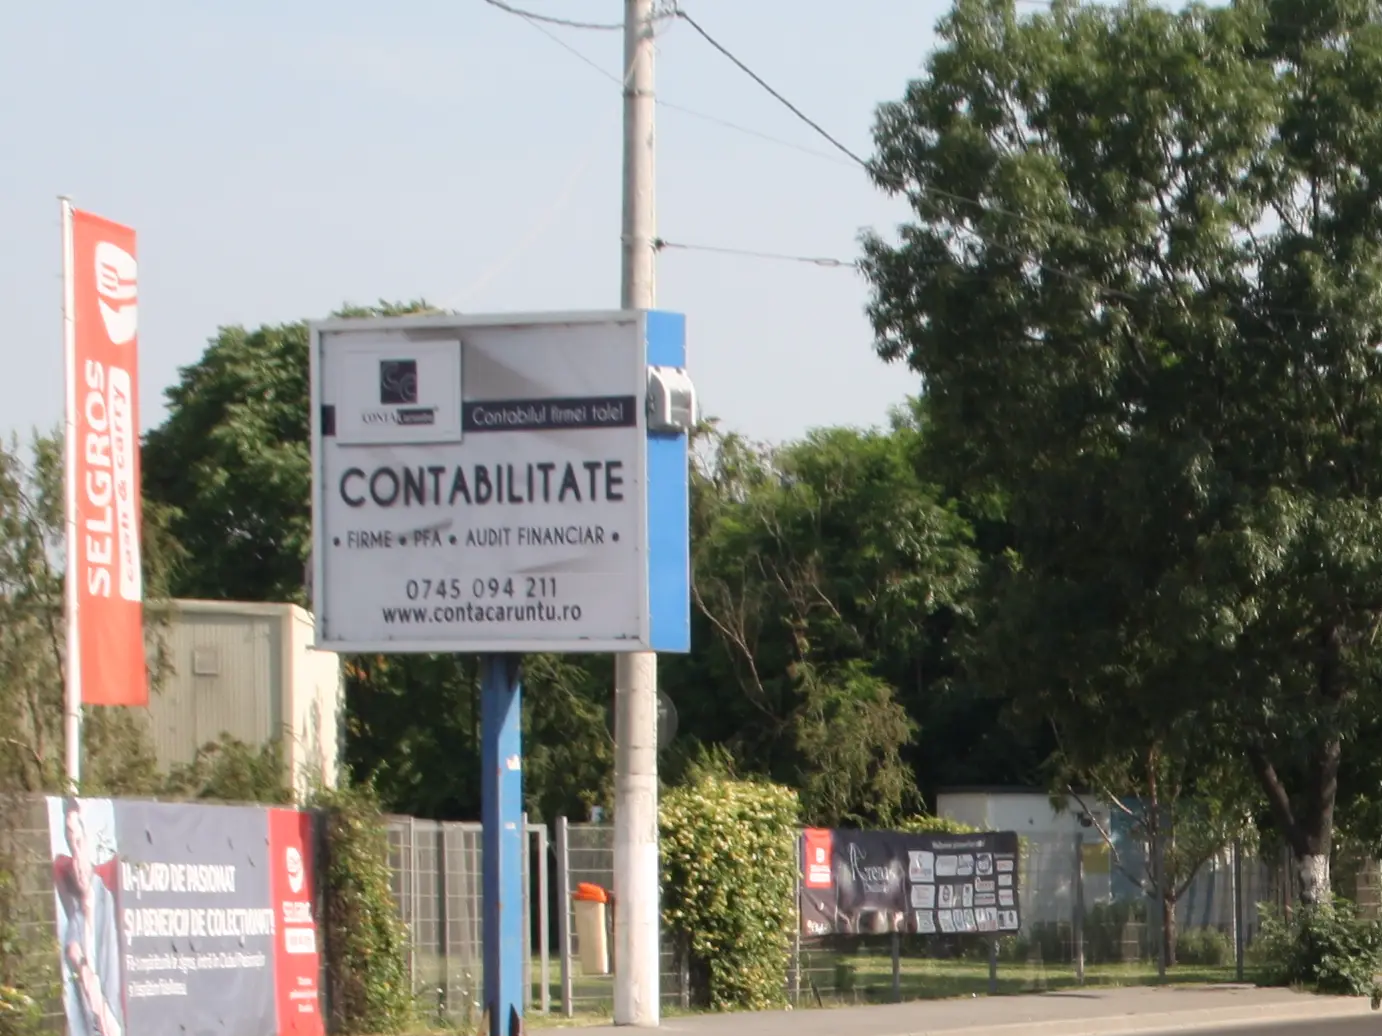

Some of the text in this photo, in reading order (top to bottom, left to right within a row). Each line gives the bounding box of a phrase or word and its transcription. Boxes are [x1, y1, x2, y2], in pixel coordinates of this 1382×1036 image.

[472, 404, 546, 426] Contabilul
[550, 403, 587, 423] firmei
[112, 385, 127, 471] carry
[85, 359, 114, 599] SELGROS
[339, 460, 625, 508] CONTABILITATE
[347, 525, 605, 548] FIRME PFA AUDIT FINANCIAR
[406, 576, 558, 600] 0745 094 211
[383, 601, 582, 623] www.contacaruntu.ro
